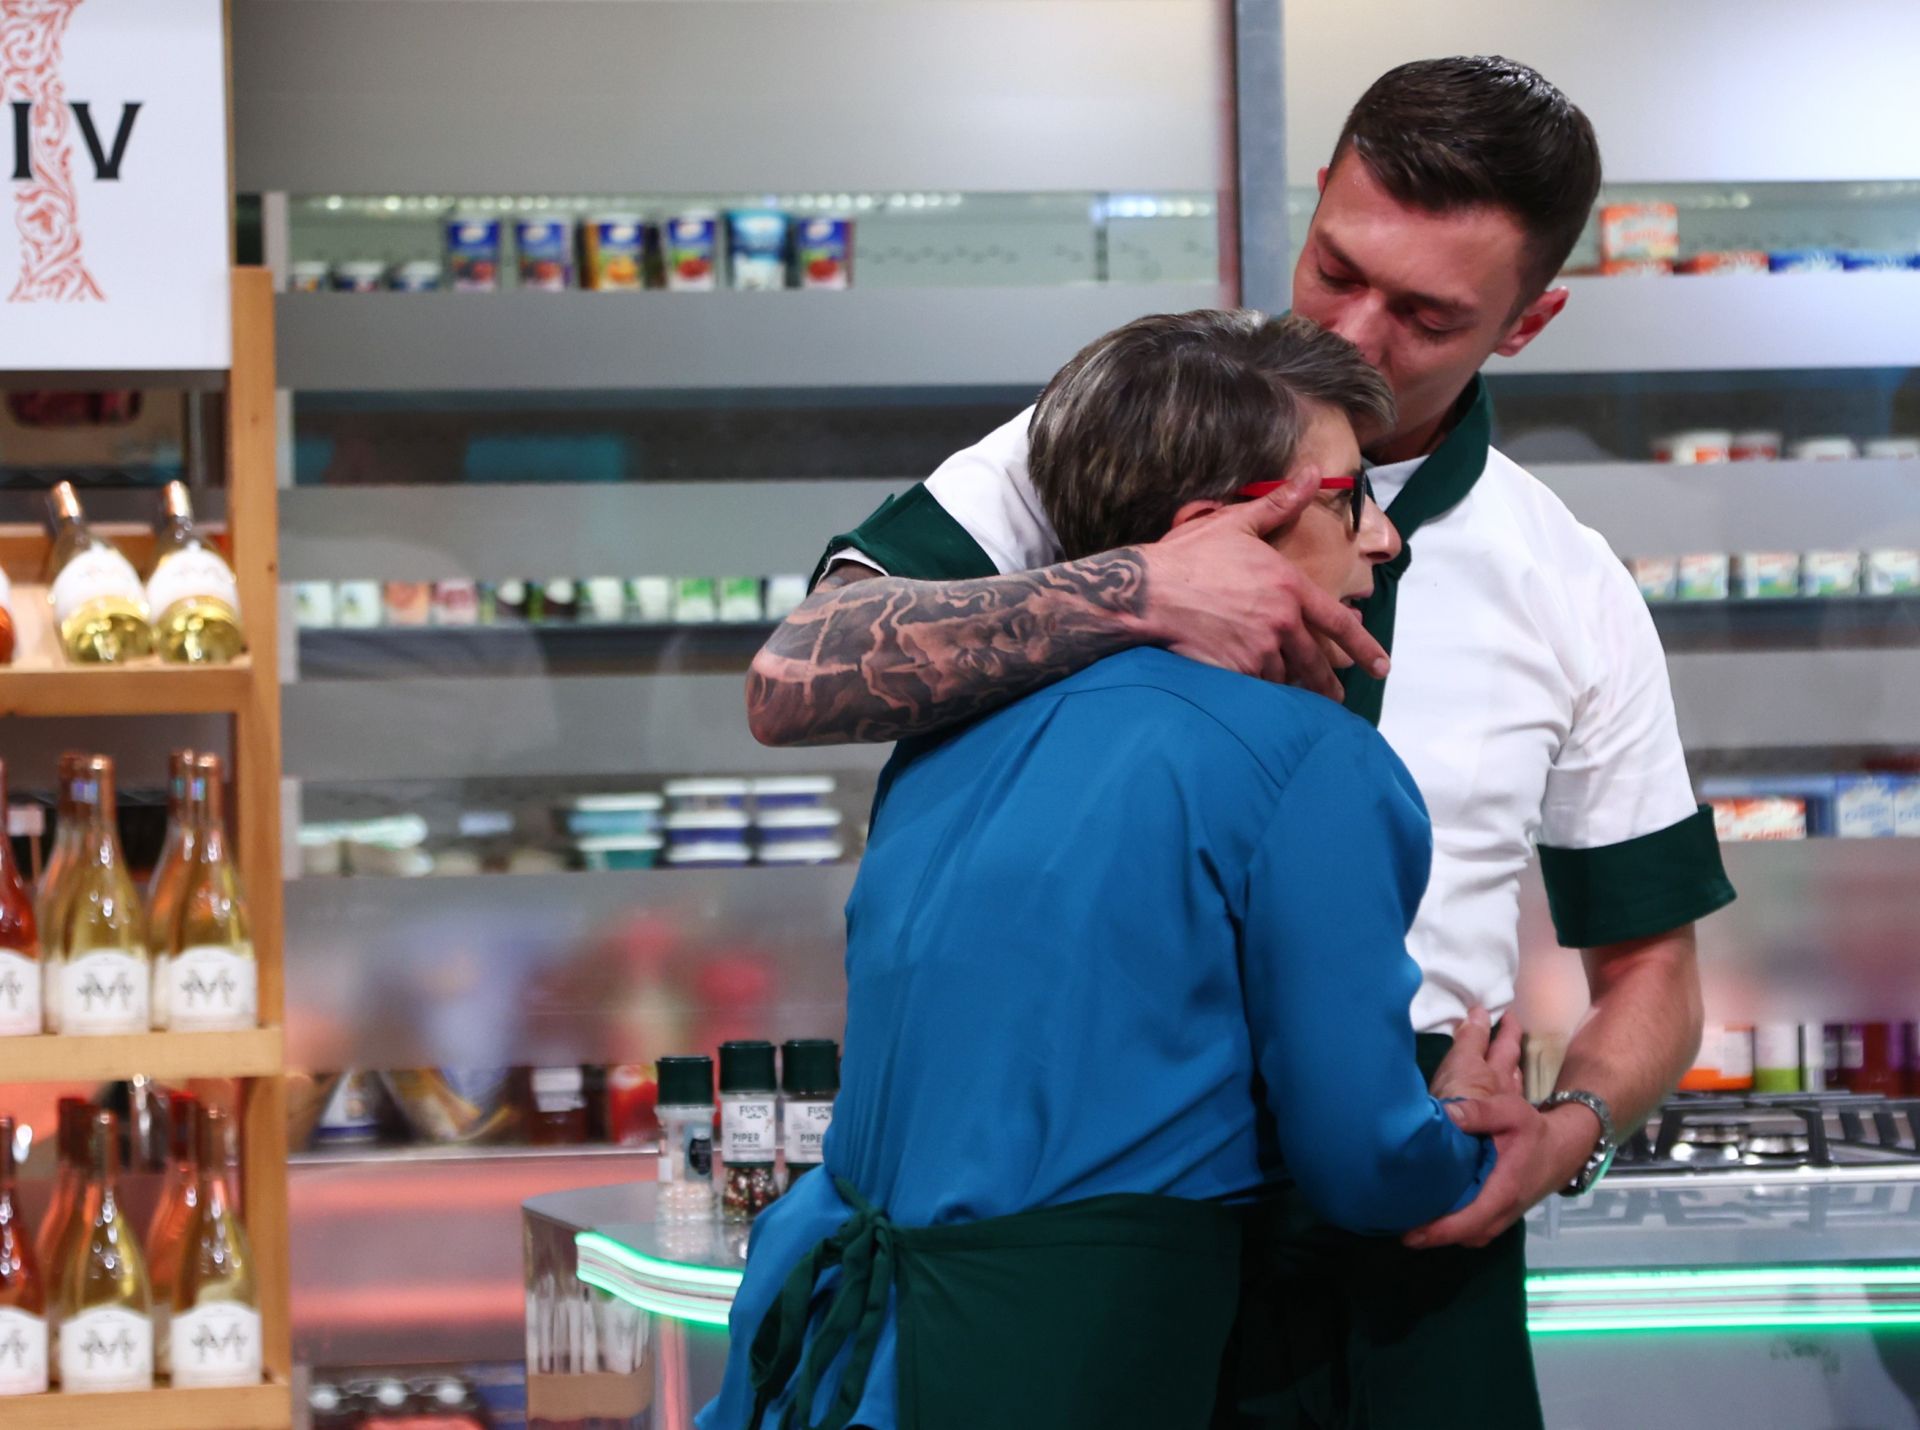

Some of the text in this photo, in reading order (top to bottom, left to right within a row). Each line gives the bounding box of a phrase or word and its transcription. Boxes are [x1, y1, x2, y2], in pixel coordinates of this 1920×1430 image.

[739, 1104, 769, 1117] FUCHS
[807, 1105, 832, 1117] FUCH
[732, 1132, 760, 1142] PIPER
[800, 1133, 823, 1142] PIPE
